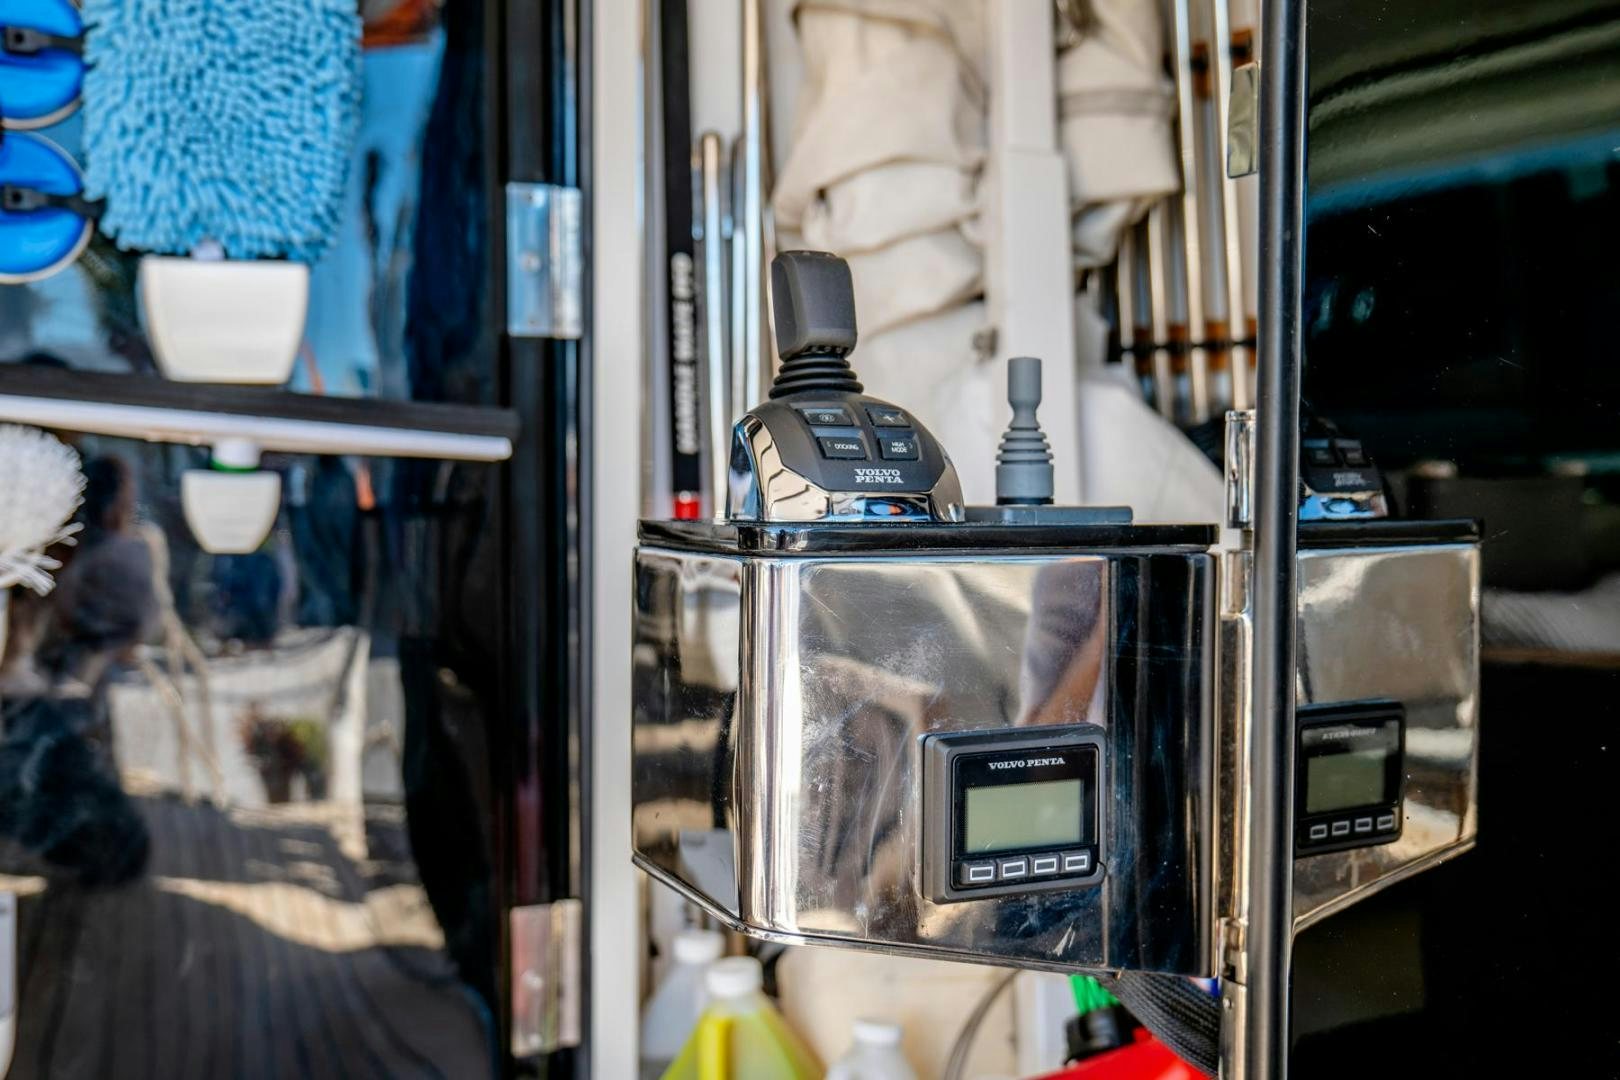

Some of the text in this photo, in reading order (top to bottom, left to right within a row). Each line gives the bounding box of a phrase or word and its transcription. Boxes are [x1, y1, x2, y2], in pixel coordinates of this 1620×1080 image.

[855, 476, 904, 484] PENTA
[989, 758, 1065, 770] VOLVO PENTA
